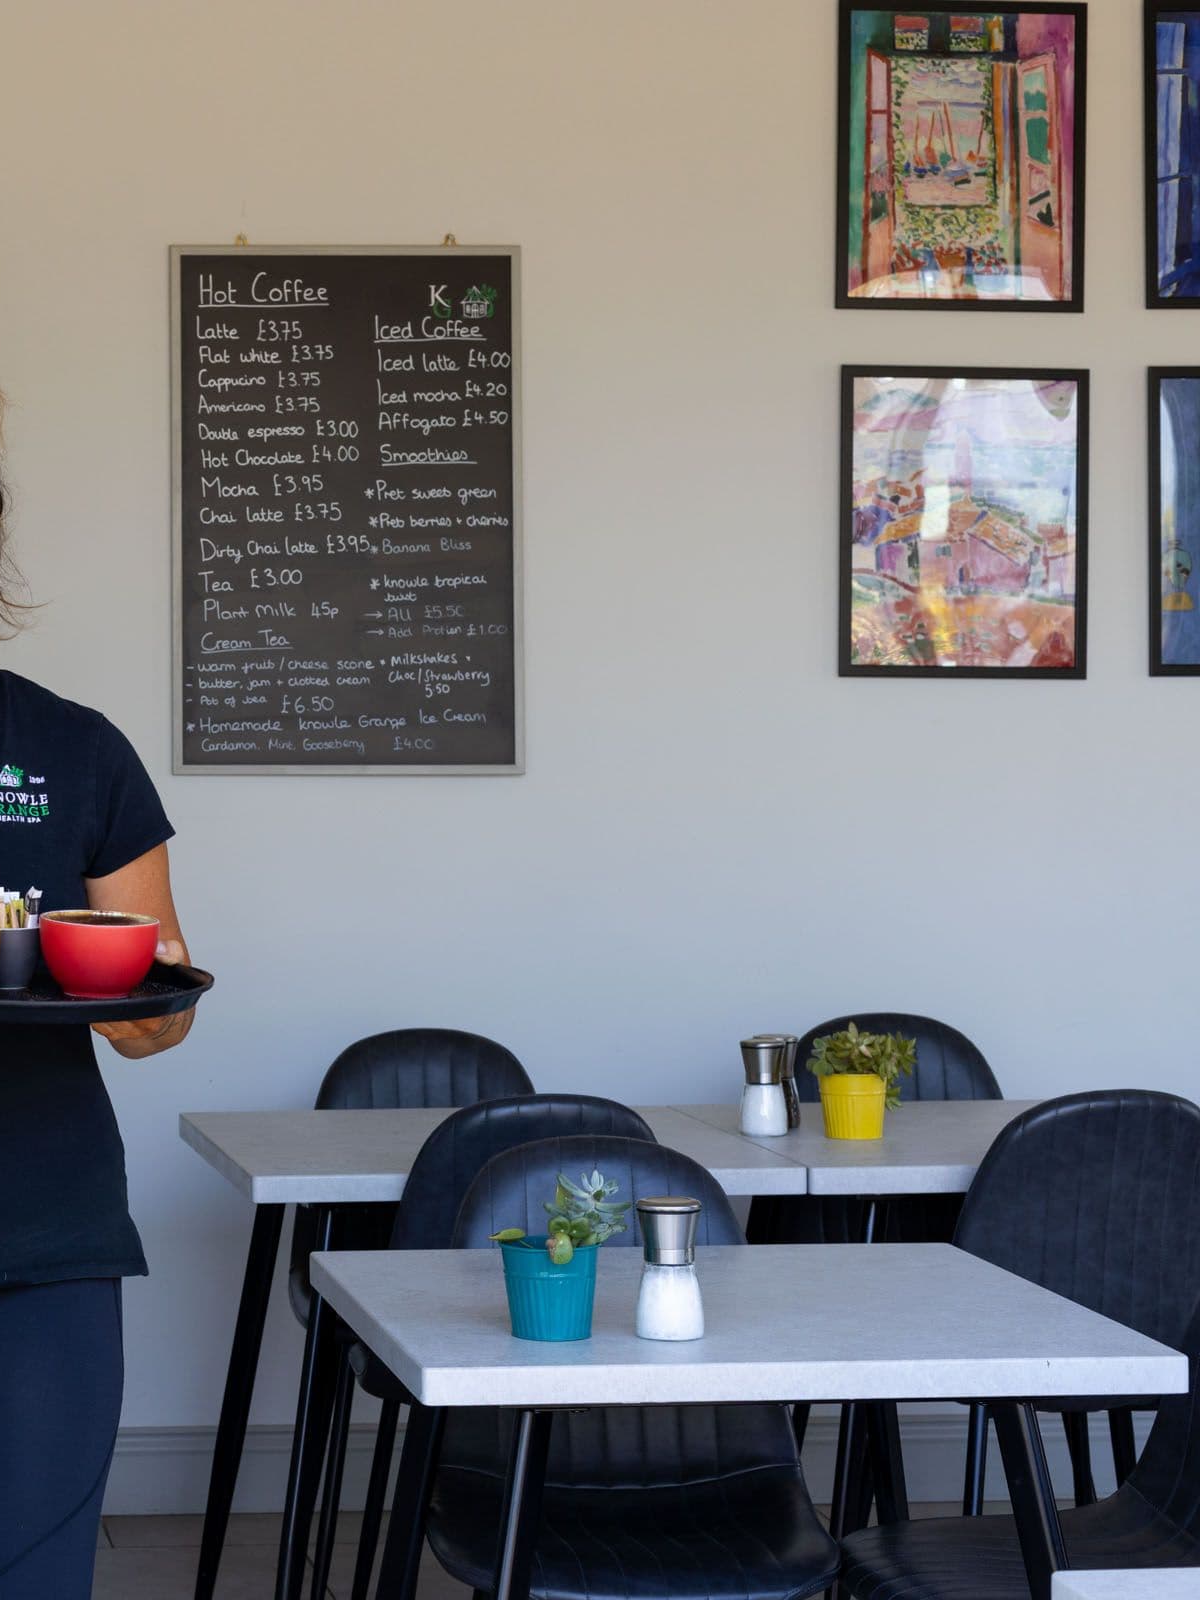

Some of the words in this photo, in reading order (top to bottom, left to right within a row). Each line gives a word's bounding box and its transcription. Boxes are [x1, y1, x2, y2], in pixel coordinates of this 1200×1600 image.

[200, 273, 238, 305] Hot
[252, 271, 329, 303] Coffee
[428, 284, 452, 308] K
[196, 315, 241, 340] Latte
[256, 318, 303, 342] £3.75
[375, 314, 415, 339] Iced
[421, 315, 484, 339] Coffee
[199, 345, 232, 364] Flat
[240, 348, 283, 364] white
[291, 344, 335, 363] £3.75
[377, 348, 416, 373] Iced
[422, 352, 462, 373] latte
[467, 348, 511, 369] £4.00
[198, 368, 267, 394] Cappucino
[278, 370, 321, 389] £3.75
[376, 378, 409, 406] Iced
[413, 389, 463, 403] mocha
[464, 379, 508, 398] £4.20
[197, 394, 267, 415] Americano
[274, 395, 321, 414] £3.75
[198, 422, 240, 441] Double
[247, 425, 306, 443] espresso
[316, 419, 359, 438] £3.00
[378, 411, 457, 436] Affogato
[461, 408, 509, 427] £4.50
[200, 448, 231, 469] Hot
[234, 448, 306, 466] Chocolate
[312, 444, 360, 463] £4.00
[379, 443, 469, 463] Smoothies
[200, 476, 260, 498] Mocha
[273, 473, 324, 496] £3.95
[411, 487, 452, 500] sweet
[457, 486, 497, 507] green
[200, 506, 238, 525] Chai
[245, 505, 286, 523] latte
[294, 501, 343, 522] £3.75
[409, 514, 453, 528] berries
[465, 512, 510, 528] cherries
[200, 537, 245, 565] Dirty
[246, 539, 281, 556] Chai
[326, 533, 371, 554] £3.95
[382, 537, 432, 555] Banana
[440, 536, 473, 551] Bliss
[198, 570, 235, 593] Tea
[434, 573, 488, 589] tropical
[203, 598, 250, 622] Plant
[311, 601, 340, 619] 45p
[200, 631, 251, 651] Cream
[257, 628, 292, 647] Tea
[387, 627, 413, 639] Add
[197, 662, 237, 673] warm
[287, 659, 330, 671] cheese
[336, 659, 376, 671] scone
[390, 652, 459, 668] Milkshakes
[245, 678, 272, 691] jam
[287, 677, 330, 687] clotted
[335, 675, 371, 686] cream
[224, 695, 237, 708] of
[242, 695, 269, 706] tea
[200, 716, 285, 734] Homemade
[358, 714, 407, 730] Grange
[418, 708, 439, 725] Ice
[443, 708, 488, 726] Cream
